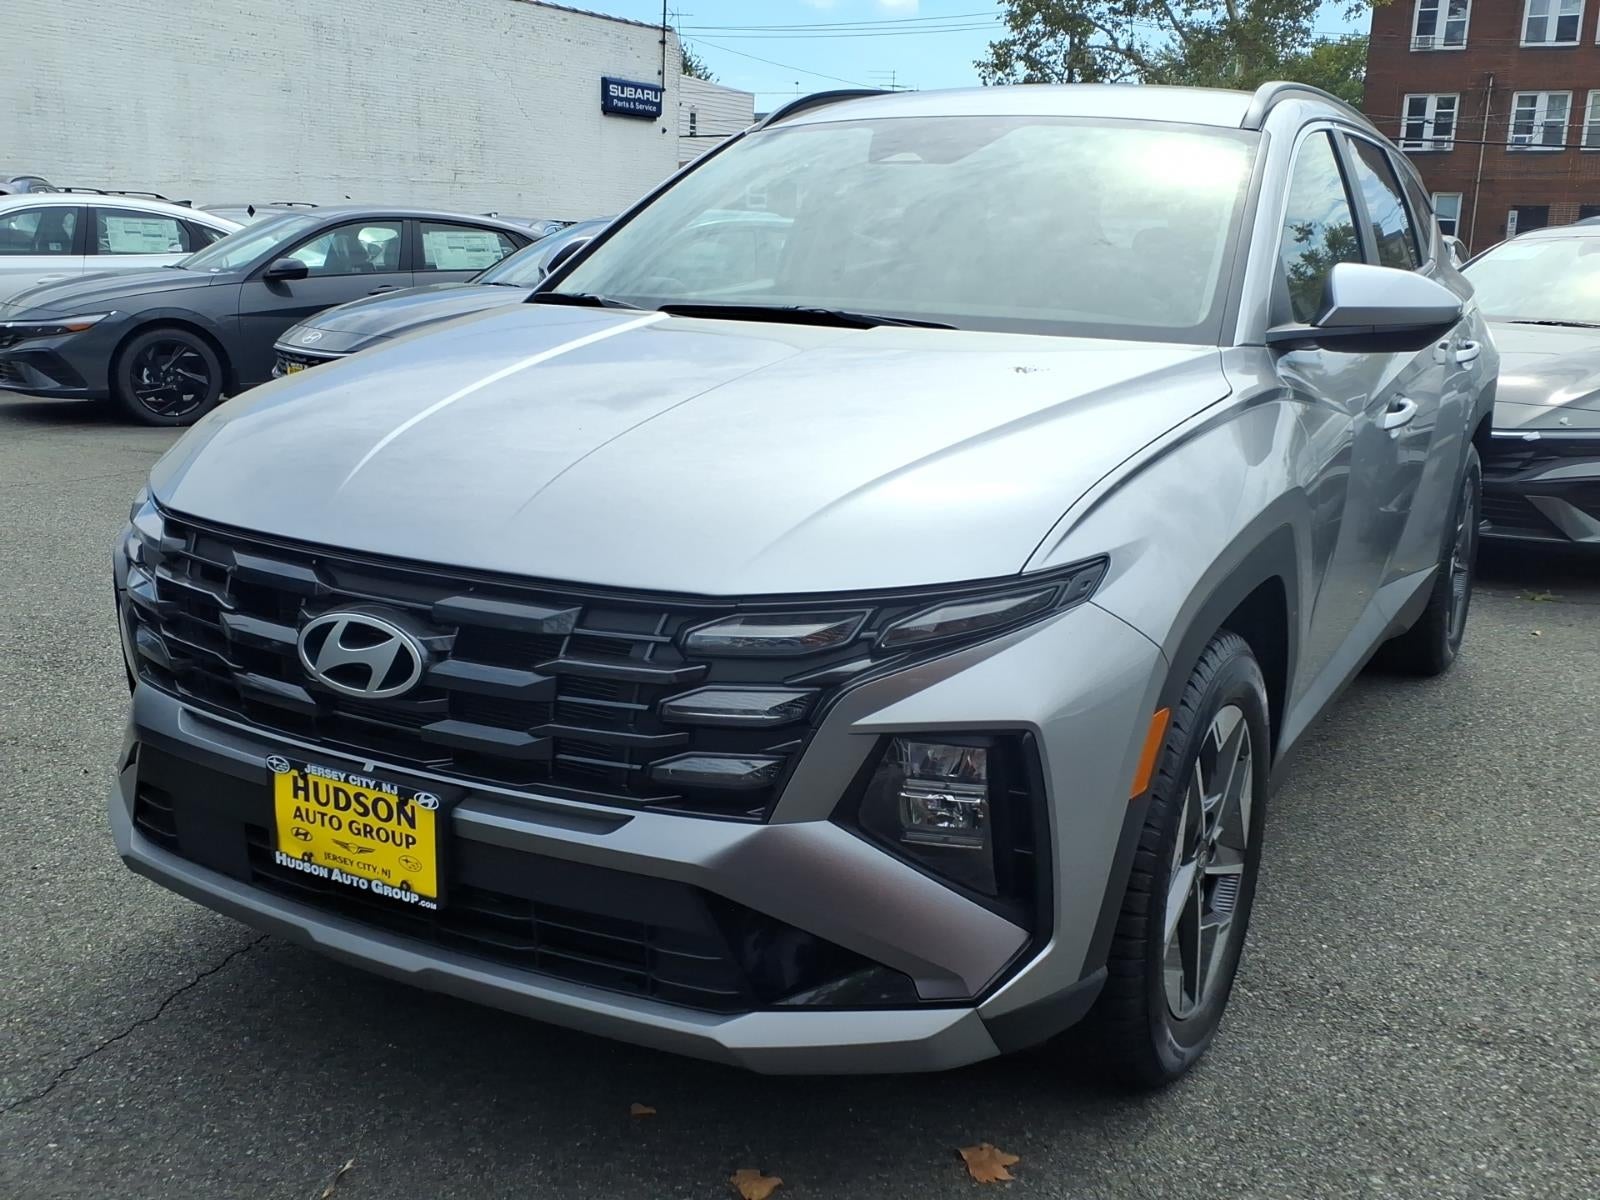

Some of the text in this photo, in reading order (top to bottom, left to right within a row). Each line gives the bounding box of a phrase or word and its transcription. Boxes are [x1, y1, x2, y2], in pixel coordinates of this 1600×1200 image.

[609, 84, 660, 102] SUBARU
[613, 98, 657, 112] Parts & Service
[304, 764, 398, 795] JERSEY CITY, NJ
[292, 774, 417, 830] HUDSON
[293, 806, 417, 849] AUTO GROUP
[275, 851, 329, 878] HUDSON
[331, 868, 368, 889] AUTO
[324, 852, 391, 879] JERSEY CITY, NJ
